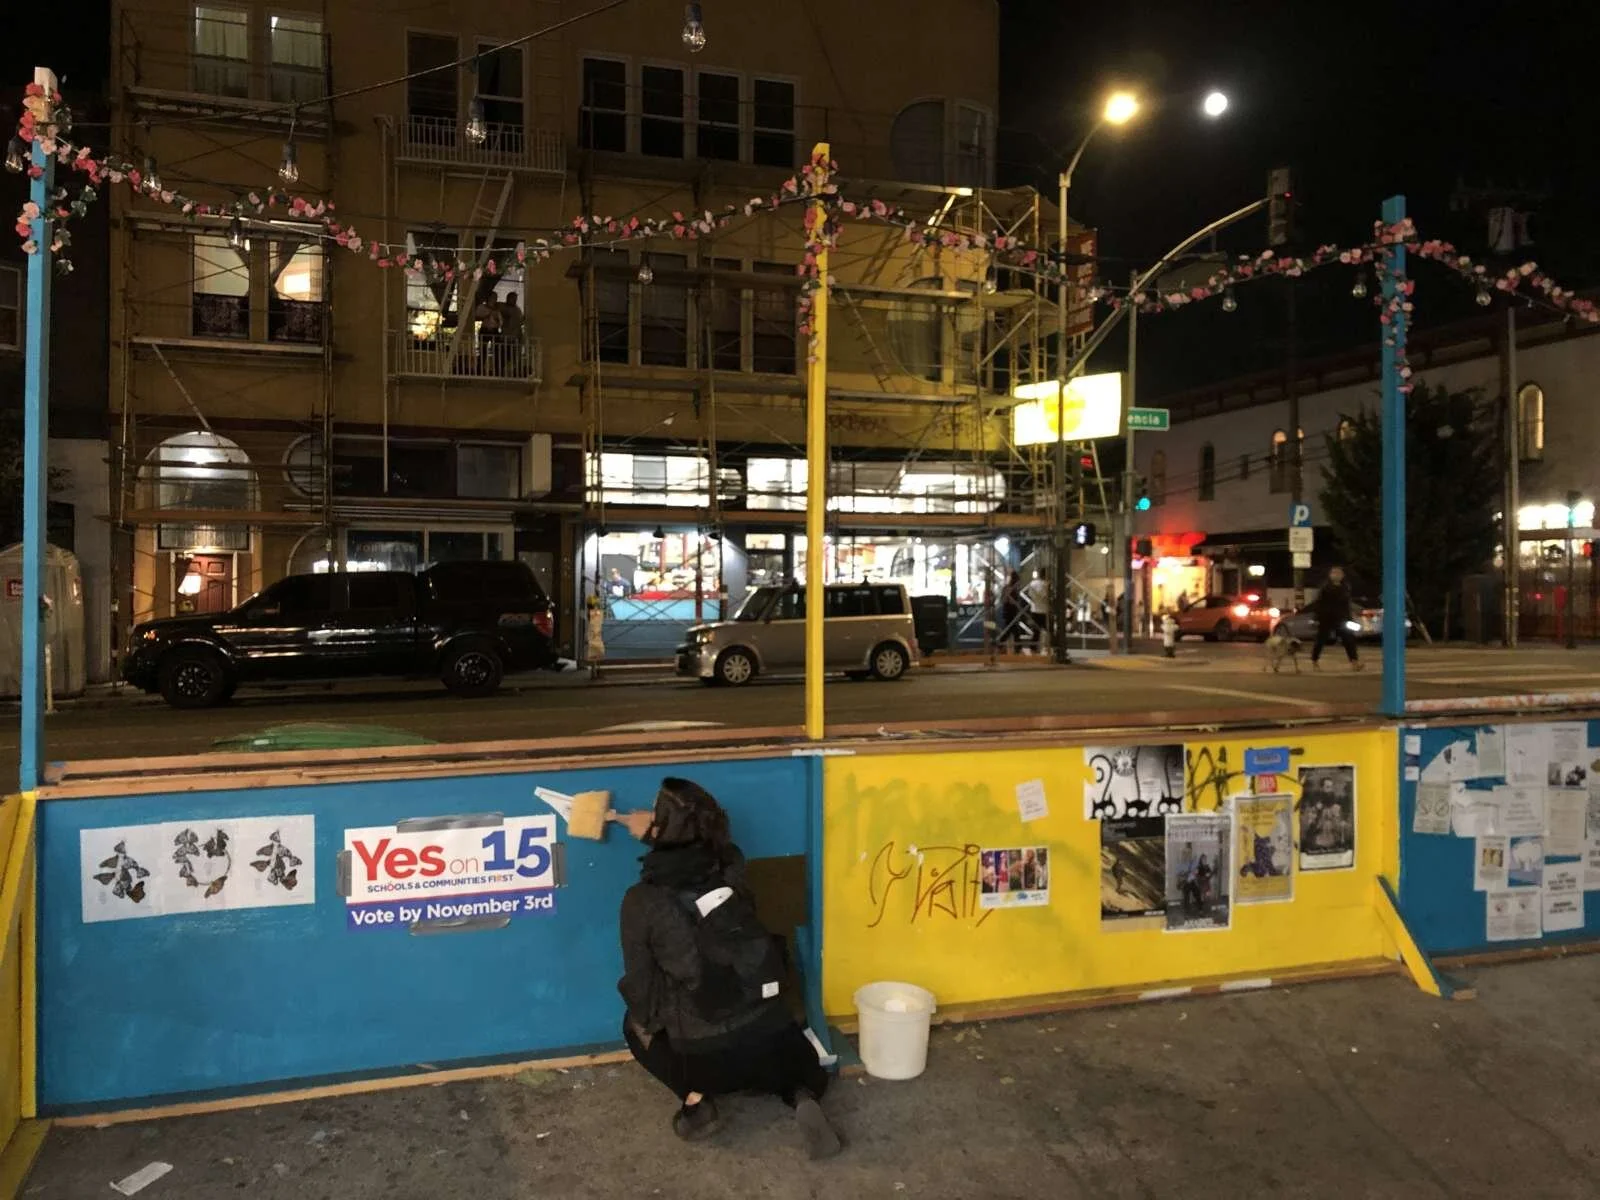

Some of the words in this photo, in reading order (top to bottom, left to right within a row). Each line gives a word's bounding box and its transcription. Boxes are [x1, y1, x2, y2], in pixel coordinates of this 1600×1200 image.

[352, 838, 446, 881] Yes
[450, 856, 479, 875] on
[482, 827, 551, 878] 15
[367, 881, 413, 893] SCHOOLS
[422, 875, 487, 889] COMMUNITIES
[351, 908, 395, 926] Vote
[399, 906, 422, 923] by
[427, 898, 520, 919] November
[524, 894, 553, 911] 3rd
